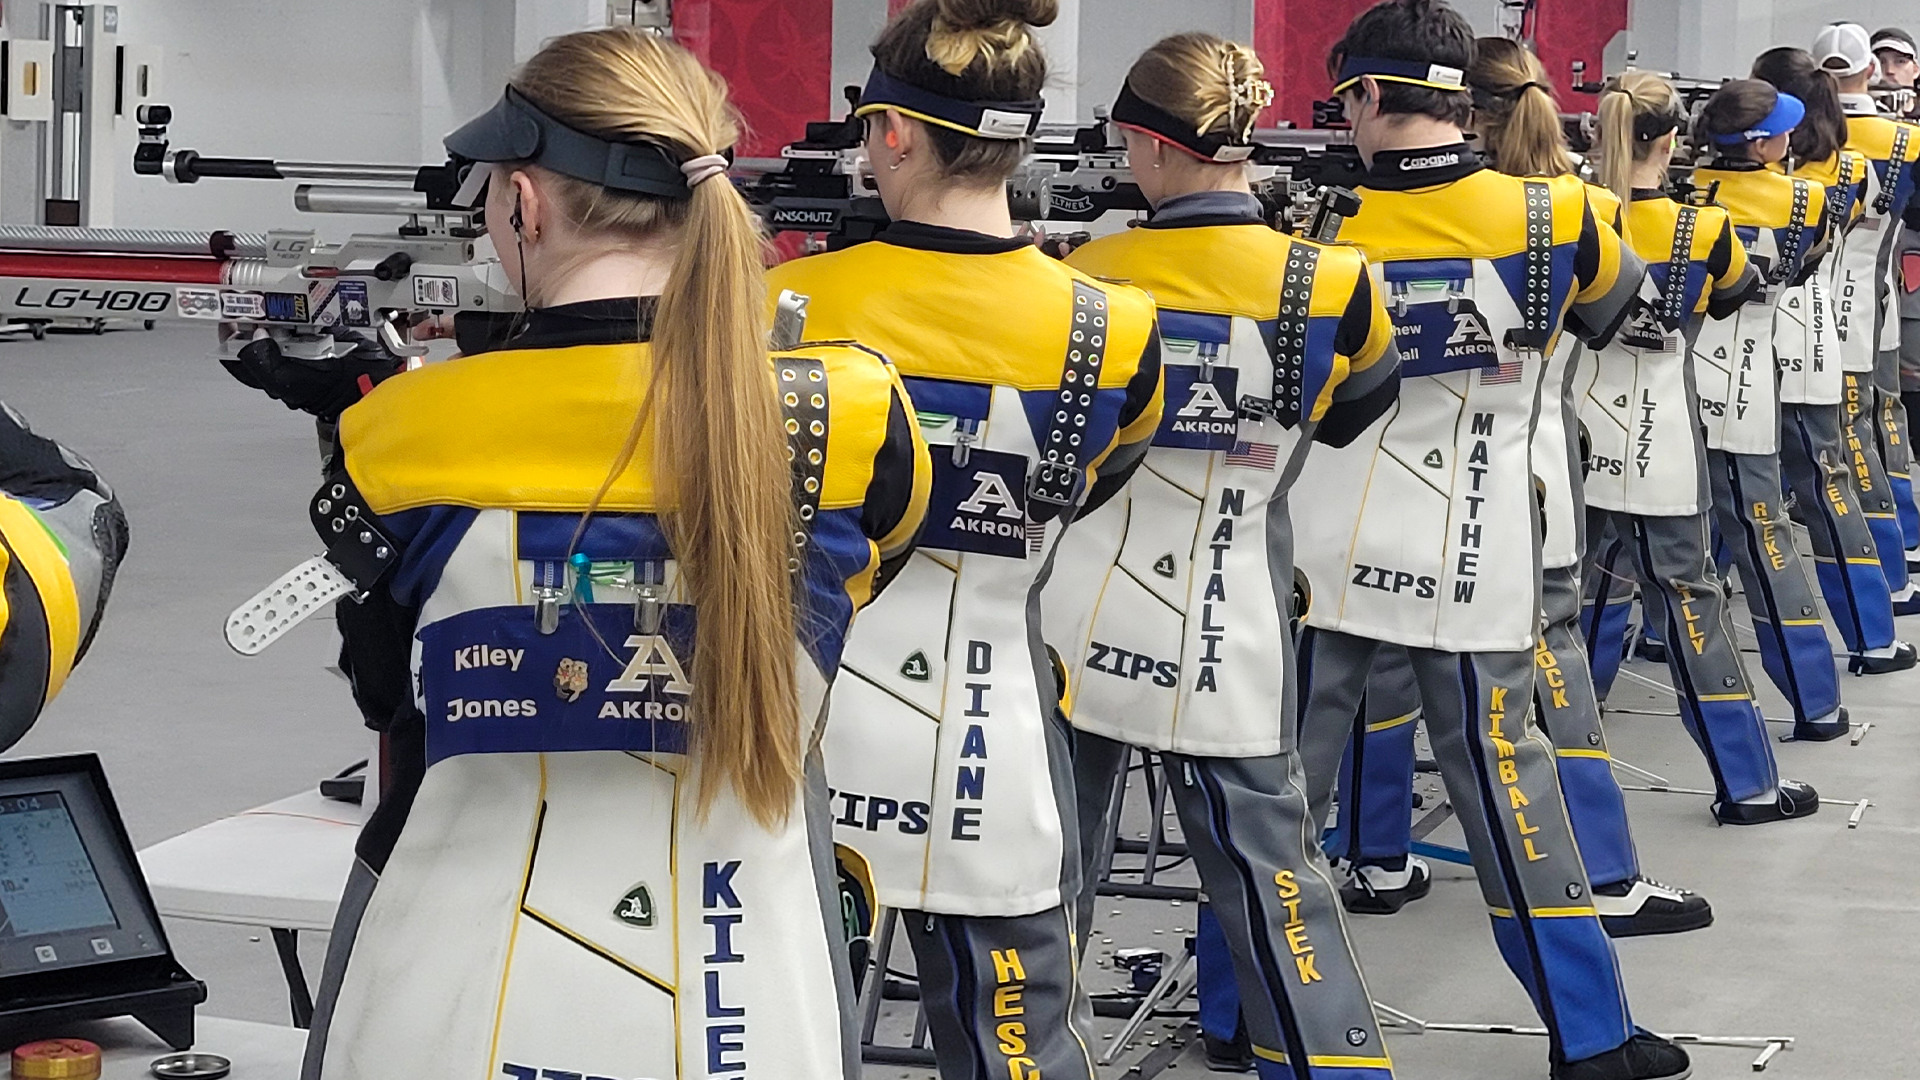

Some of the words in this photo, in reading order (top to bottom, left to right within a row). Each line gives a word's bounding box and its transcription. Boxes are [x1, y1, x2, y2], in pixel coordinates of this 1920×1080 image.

[1050, 197, 1085, 210] ALTHER
[1290, 183, 1309, 192] HER
[272, 240, 307, 252] LG
[14, 285, 172, 313] LG400
[1838, 269, 1856, 342] LOGAN
[1392, 324, 1422, 337] hew
[1634, 329, 1663, 342] KRON
[1811, 270, 1824, 373] IERSTEN
[1401, 347, 1419, 361] all
[1443, 344, 1496, 358] AKRON
[1780, 357, 1803, 372] PS
[1736, 338, 1756, 421] SALLY
[1702, 398, 1726, 417] PS
[1884, 396, 1901, 446] HAHN
[1171, 420, 1237, 435] AKRON
[1635, 388, 1657, 478] LIZZY
[1590, 454, 1623, 476] IPS
[1453, 412, 1495, 604] MATTHEW
[950, 516, 1025, 541] AKRON
[1194, 487, 1246, 693] NATALIA
[1352, 563, 1438, 599] ZIPS
[1670, 578, 1706, 656] ILLY
[454, 644, 525, 673] Kiley
[1085, 640, 1179, 689] ZIPS
[446, 697, 538, 723] Jones
[950, 639, 993, 842] DIANE
[1487, 685, 1549, 863] KIMBALL
[828, 787, 931, 836] IPS
[1274, 870, 1323, 985] STEK
[702, 860, 747, 1080] KILE
